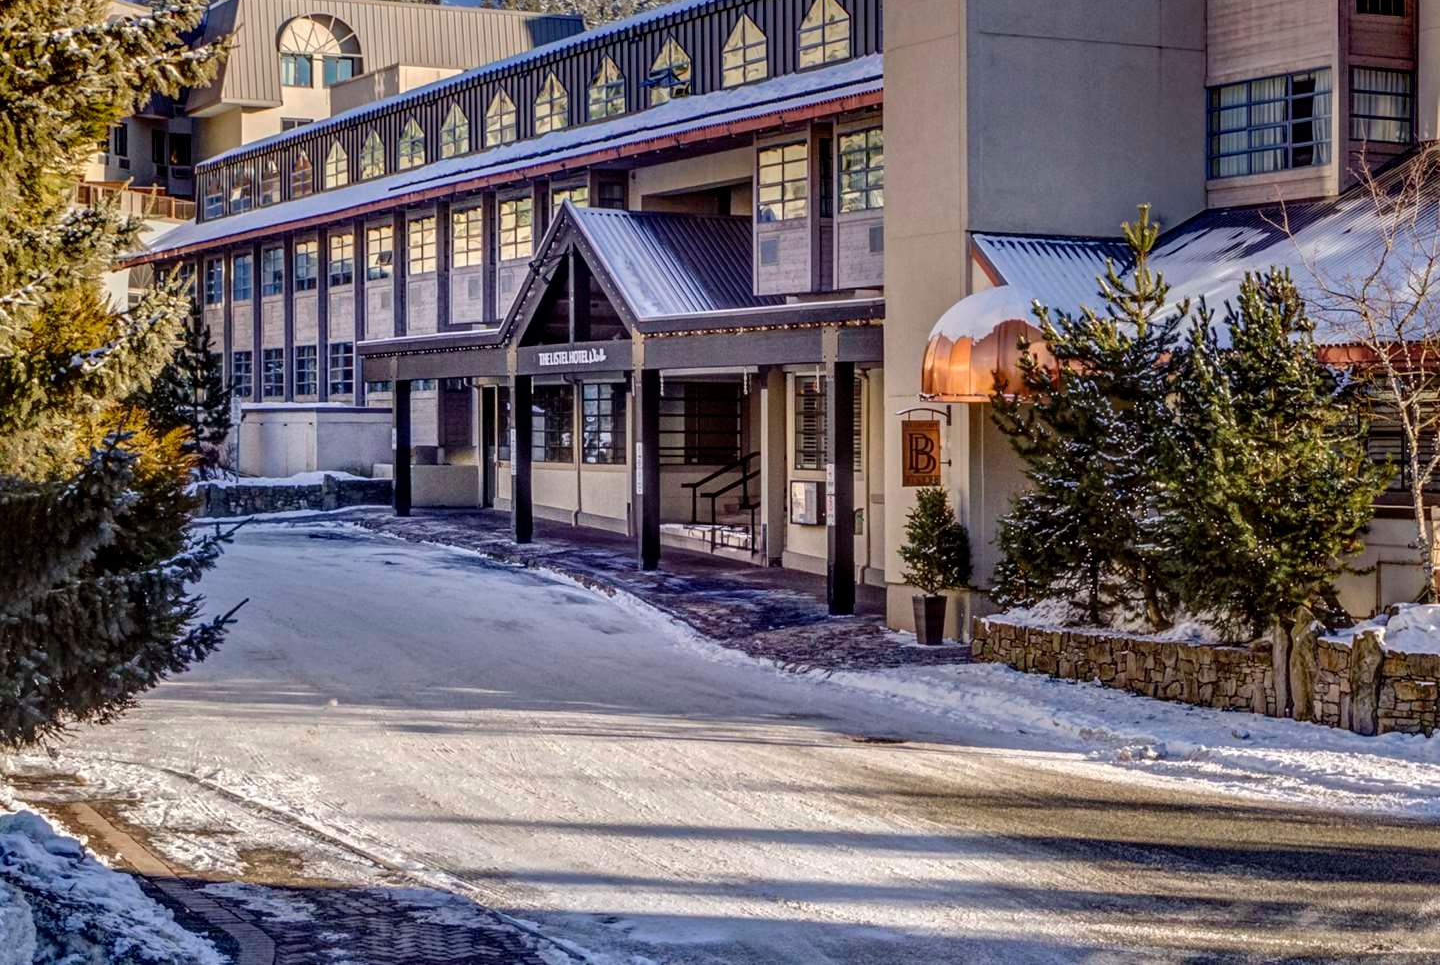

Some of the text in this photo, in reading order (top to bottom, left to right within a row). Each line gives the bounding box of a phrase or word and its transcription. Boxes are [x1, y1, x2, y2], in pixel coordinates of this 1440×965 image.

[538, 350, 588, 366] THE LISTEL HOTEL
